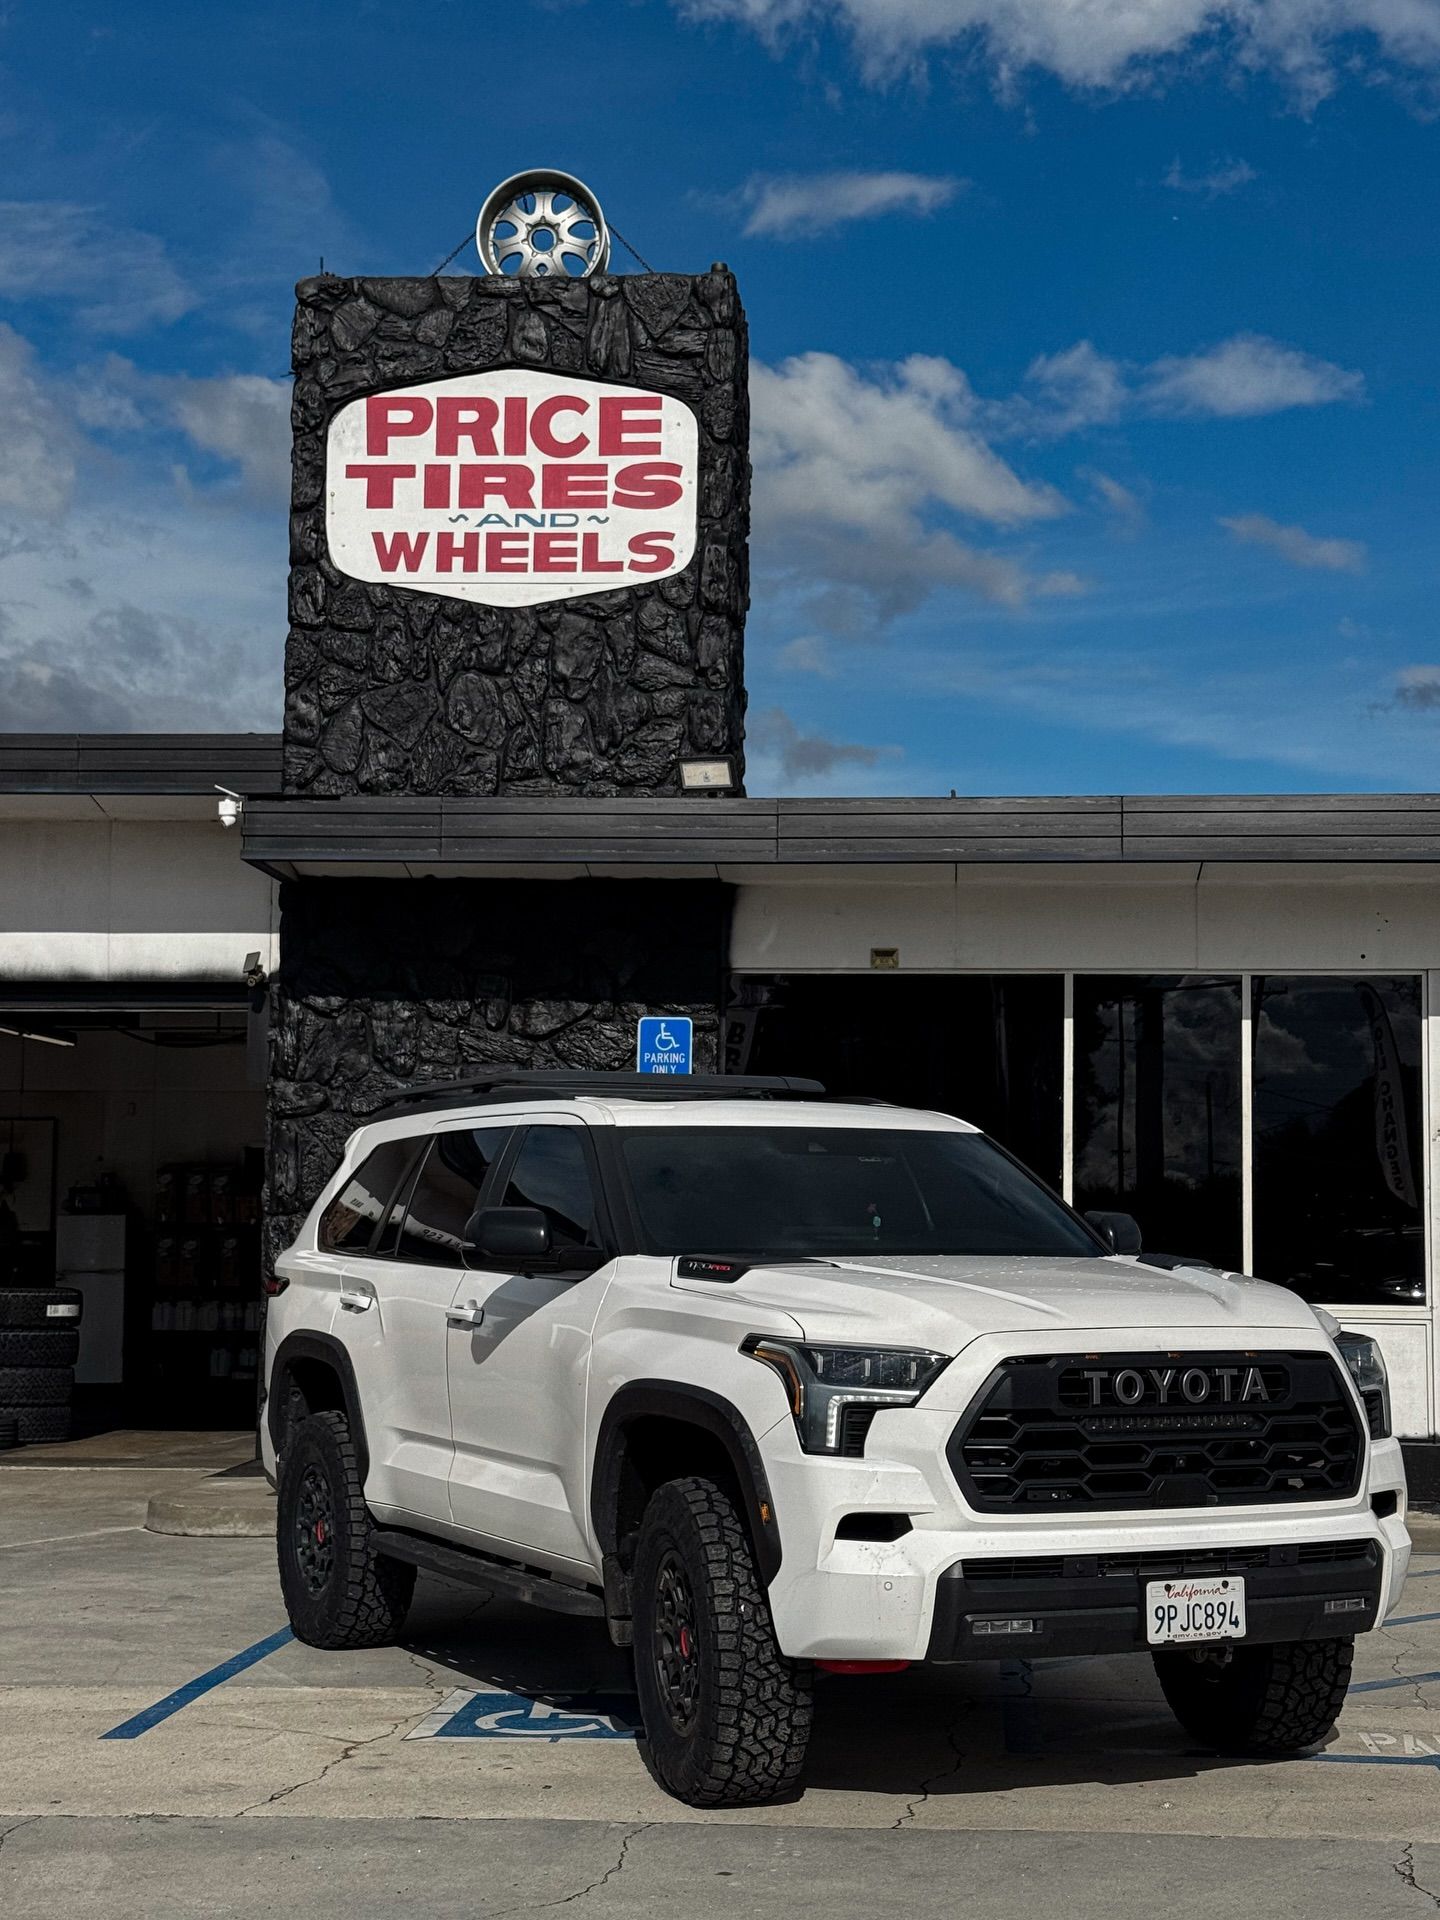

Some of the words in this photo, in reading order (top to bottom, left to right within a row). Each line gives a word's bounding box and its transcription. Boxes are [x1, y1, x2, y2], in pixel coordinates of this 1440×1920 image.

[366, 395, 663, 458] PRICE
[345, 461, 683, 510] TIRES
[474, 513, 580, 528] AND
[371, 531, 676, 573] WHEELS
[644, 1052, 686, 1064] PARKING
[1082, 1367, 1271, 1405] TOYOTA
[1167, 1584, 1227, 1601] California
[1154, 1601, 1240, 1634] 9PJC894
[1172, 1630, 1222, 1639] dmv.ca.gov
